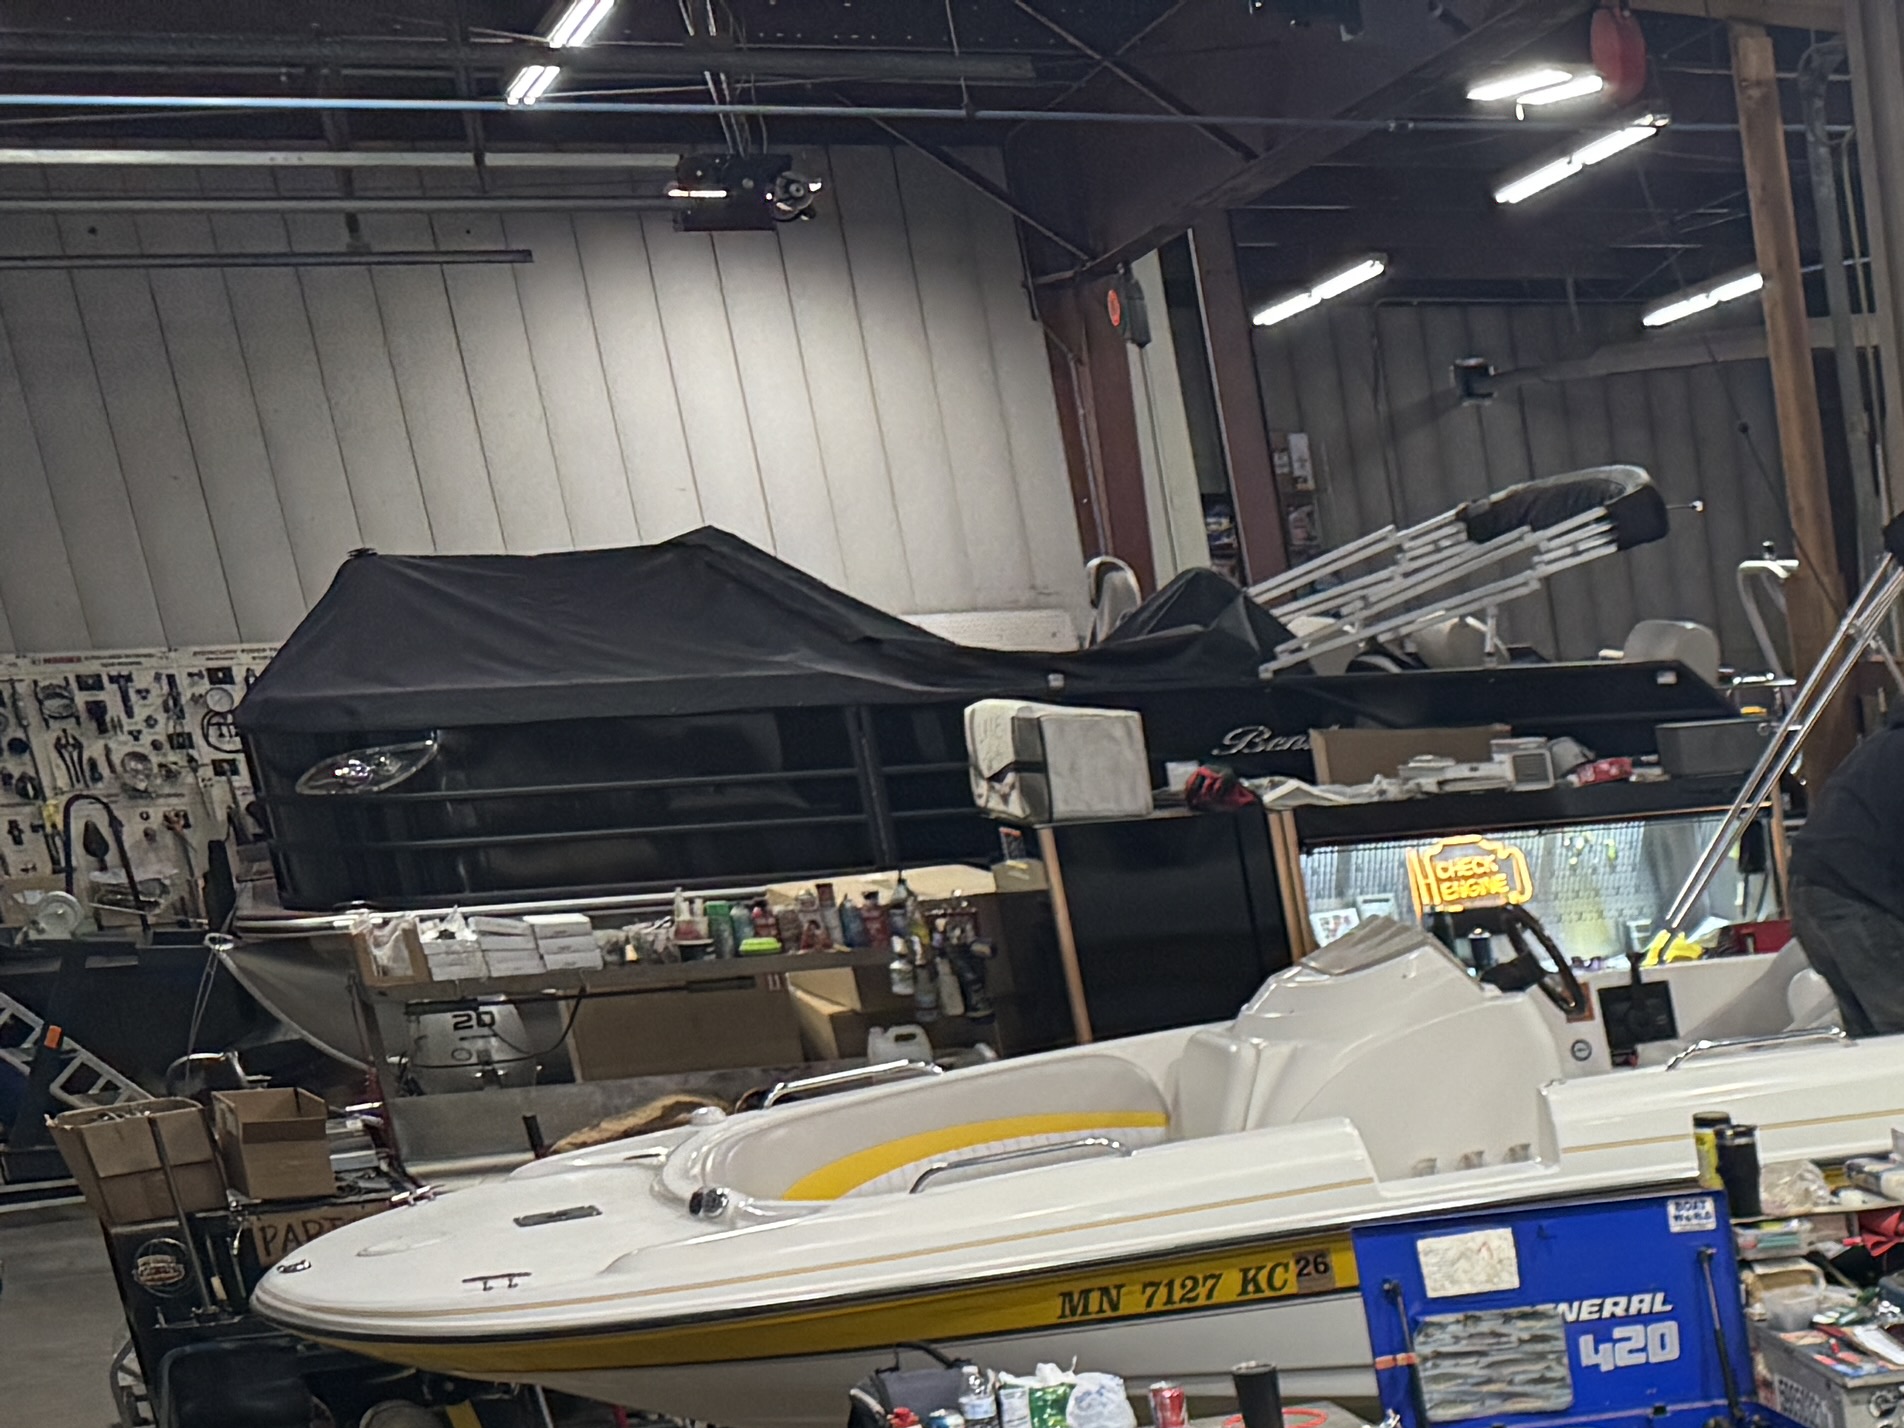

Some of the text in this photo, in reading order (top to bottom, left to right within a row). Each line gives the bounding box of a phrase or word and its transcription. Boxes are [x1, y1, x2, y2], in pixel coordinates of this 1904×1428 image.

[1436, 854, 1498, 879] CHECK
[1440, 873, 1509, 901] ENGINE
[452, 1011, 495, 1031] 20
[1057, 1254, 1329, 1319] MN 7127 KC 26
[1579, 1320, 1681, 1372] 420
